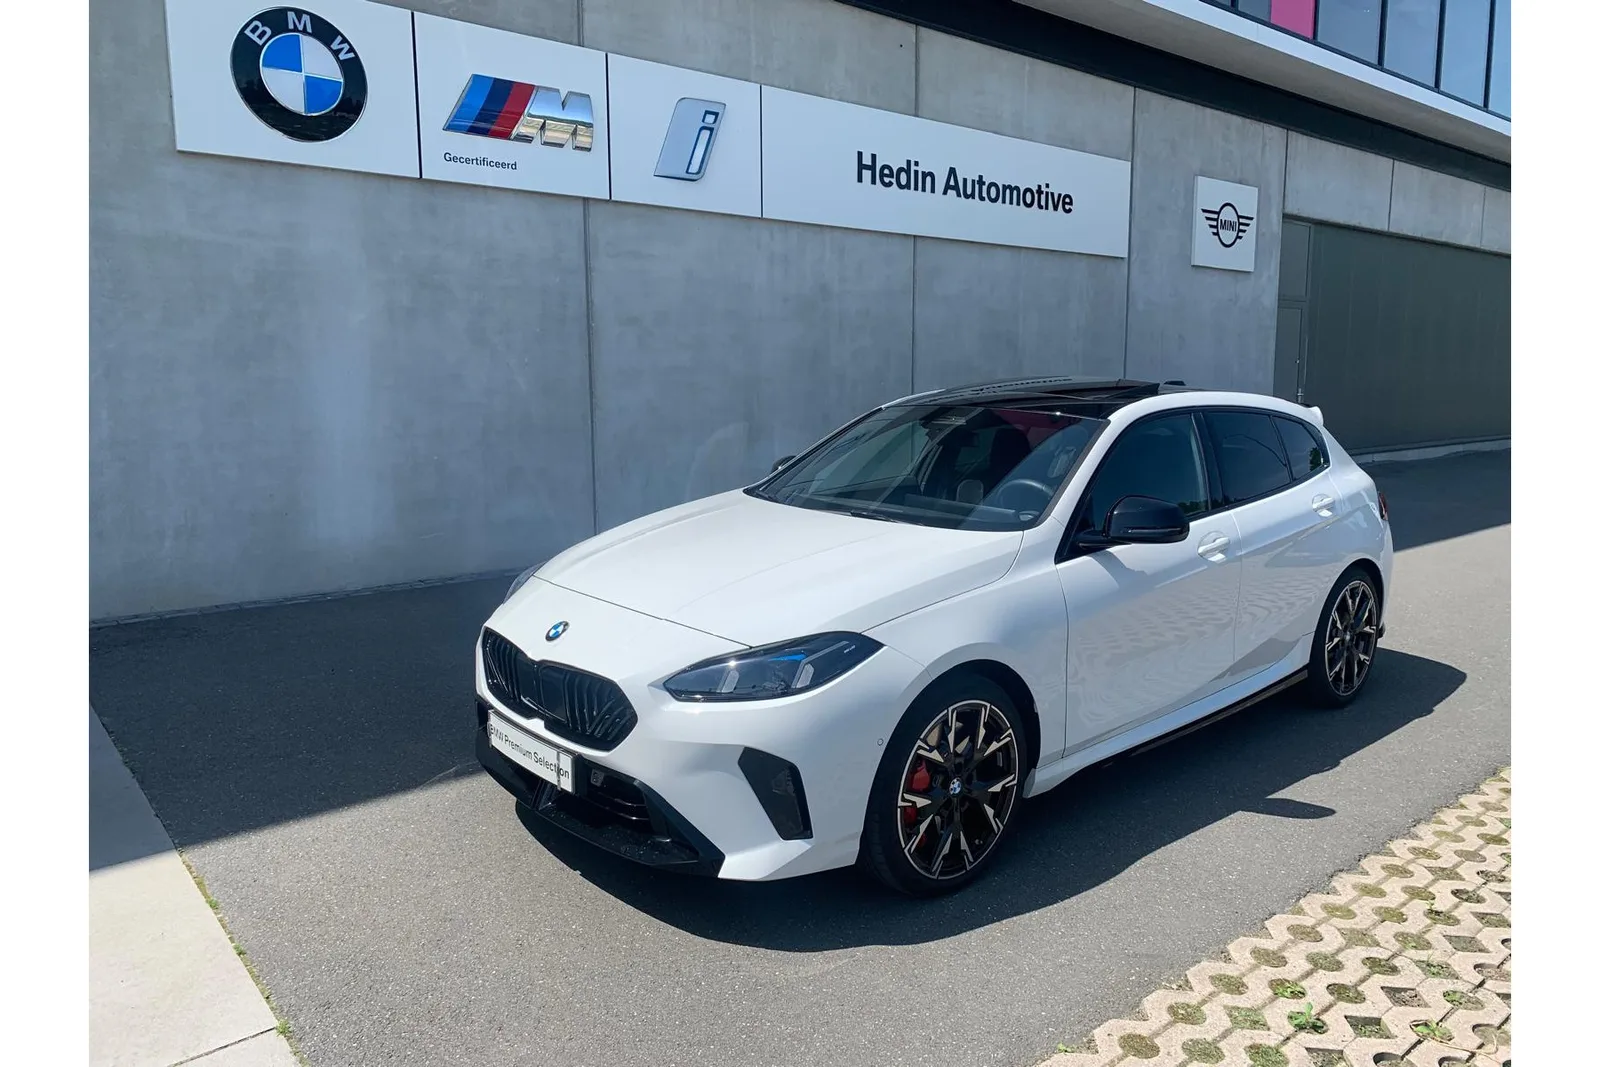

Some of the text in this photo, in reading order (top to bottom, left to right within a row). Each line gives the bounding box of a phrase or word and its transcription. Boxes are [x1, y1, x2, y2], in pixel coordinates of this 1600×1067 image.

[244, 11, 355, 61] BMW
[443, 152, 518, 171] Gecertificeerd
[857, 150, 1074, 214] Hedin Automotive
[1220, 219, 1238, 232] MINI
[504, 735, 533, 760] Premium
